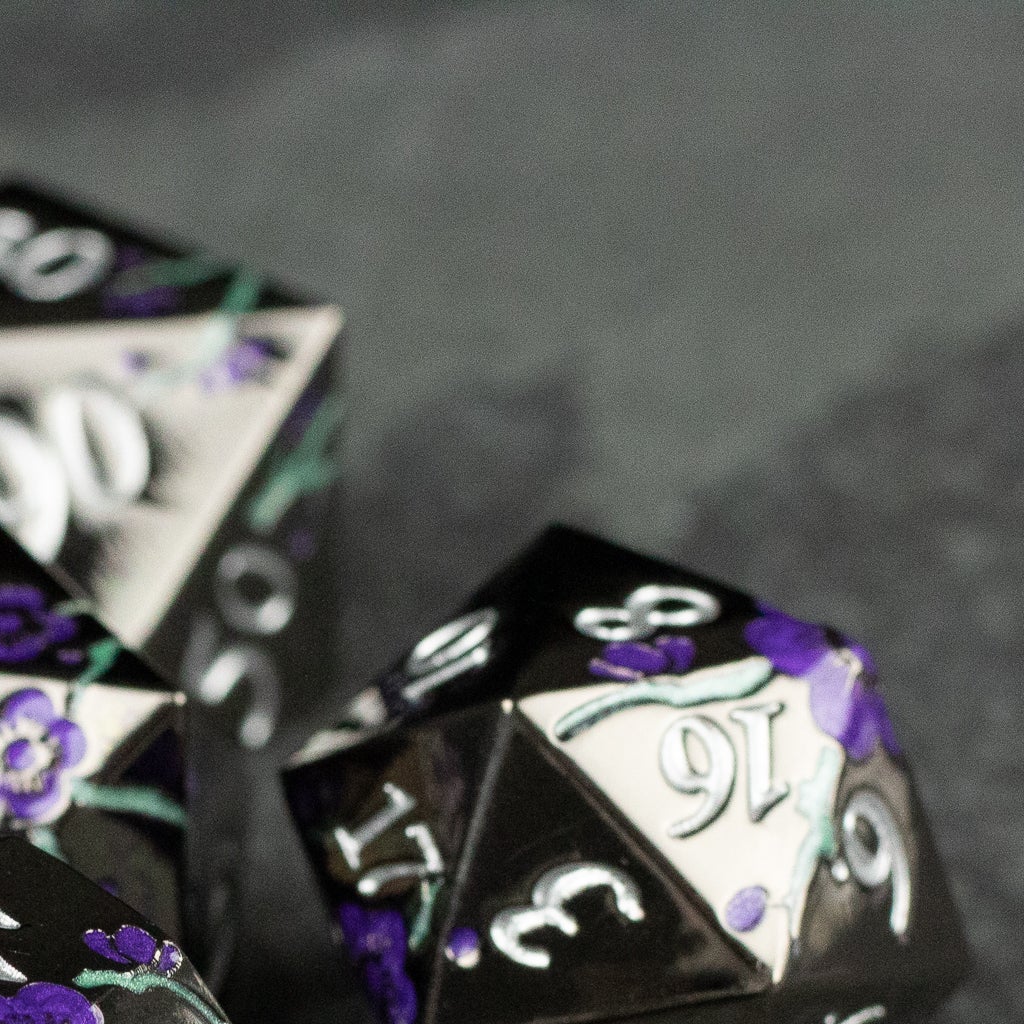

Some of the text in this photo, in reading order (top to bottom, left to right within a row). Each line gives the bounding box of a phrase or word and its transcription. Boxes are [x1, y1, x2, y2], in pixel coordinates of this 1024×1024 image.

[575, 585, 720, 641] 8
[660, 702, 789, 840] 16
[335, 783, 444, 895] 17
[490, 861, 644, 968] 3
